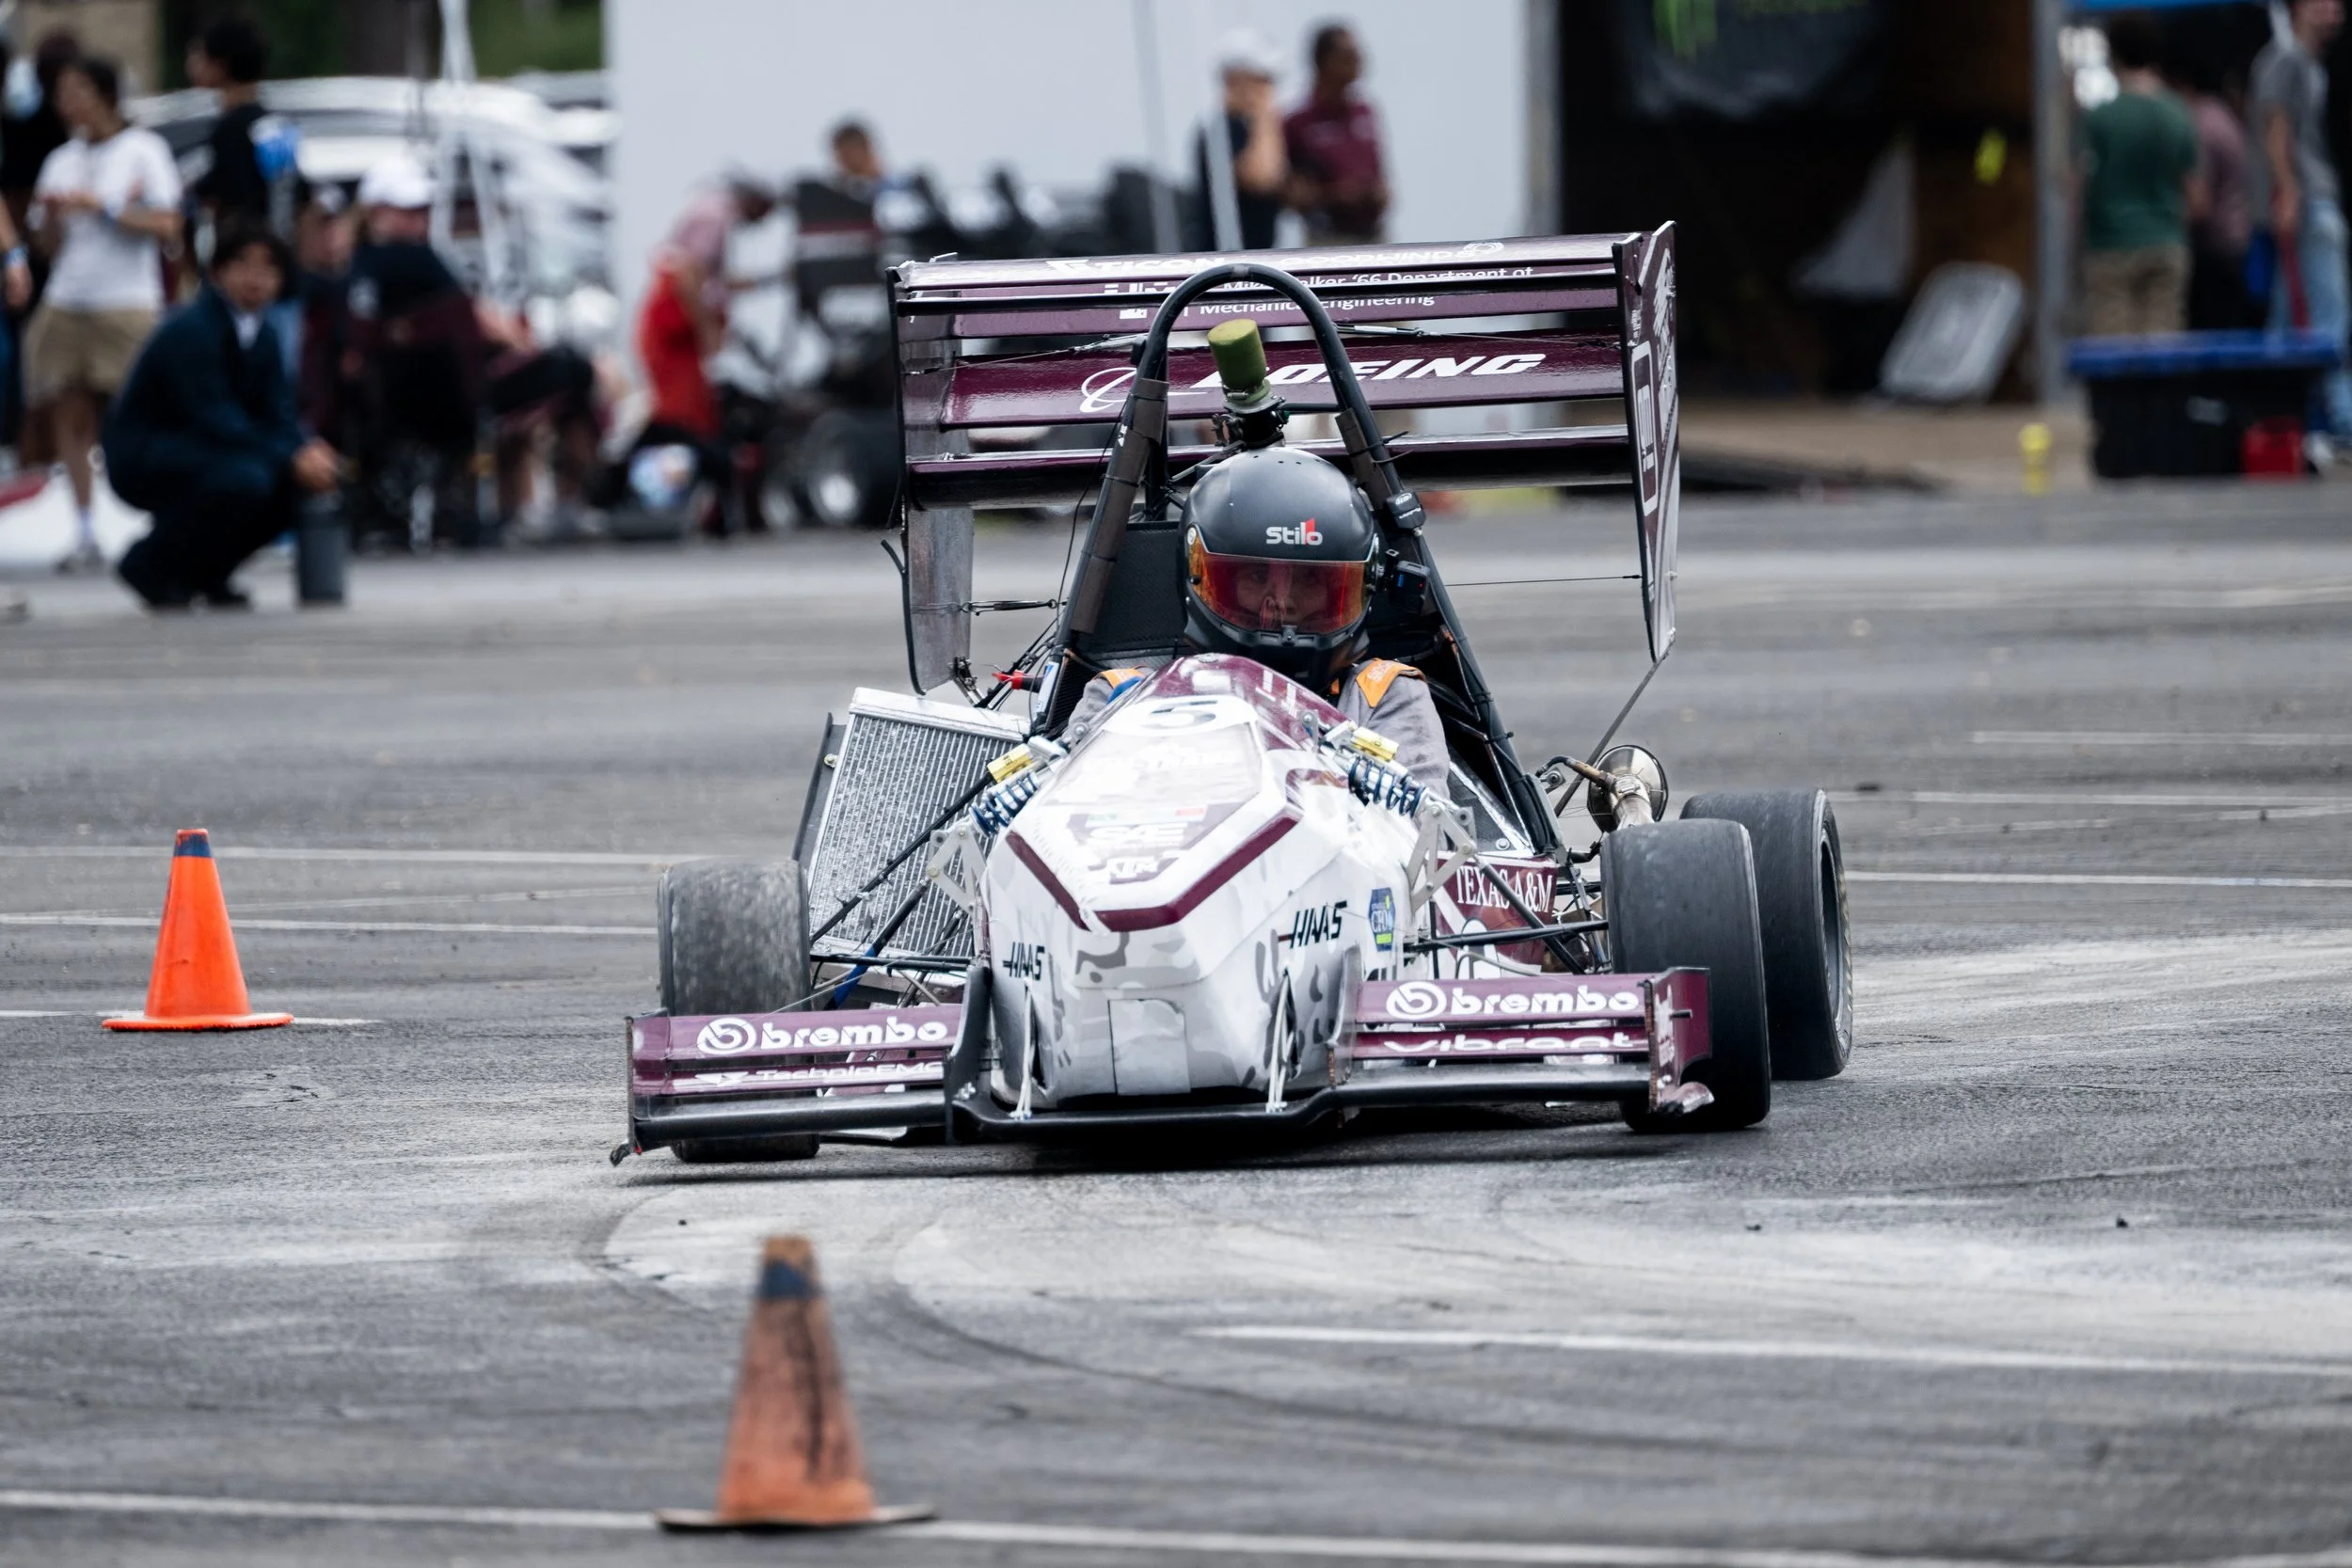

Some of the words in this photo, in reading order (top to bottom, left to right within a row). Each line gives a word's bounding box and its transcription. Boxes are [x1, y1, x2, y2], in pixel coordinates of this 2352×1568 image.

[1265, 518, 1323, 546] Stilo
[1279, 899, 1347, 949] HAAS
[1002, 942, 1045, 981] HAAS
[1451, 985, 1639, 1016] brembo
[760, 1016, 948, 1050] brembo
[1383, 1033, 1635, 1053] vibrant
